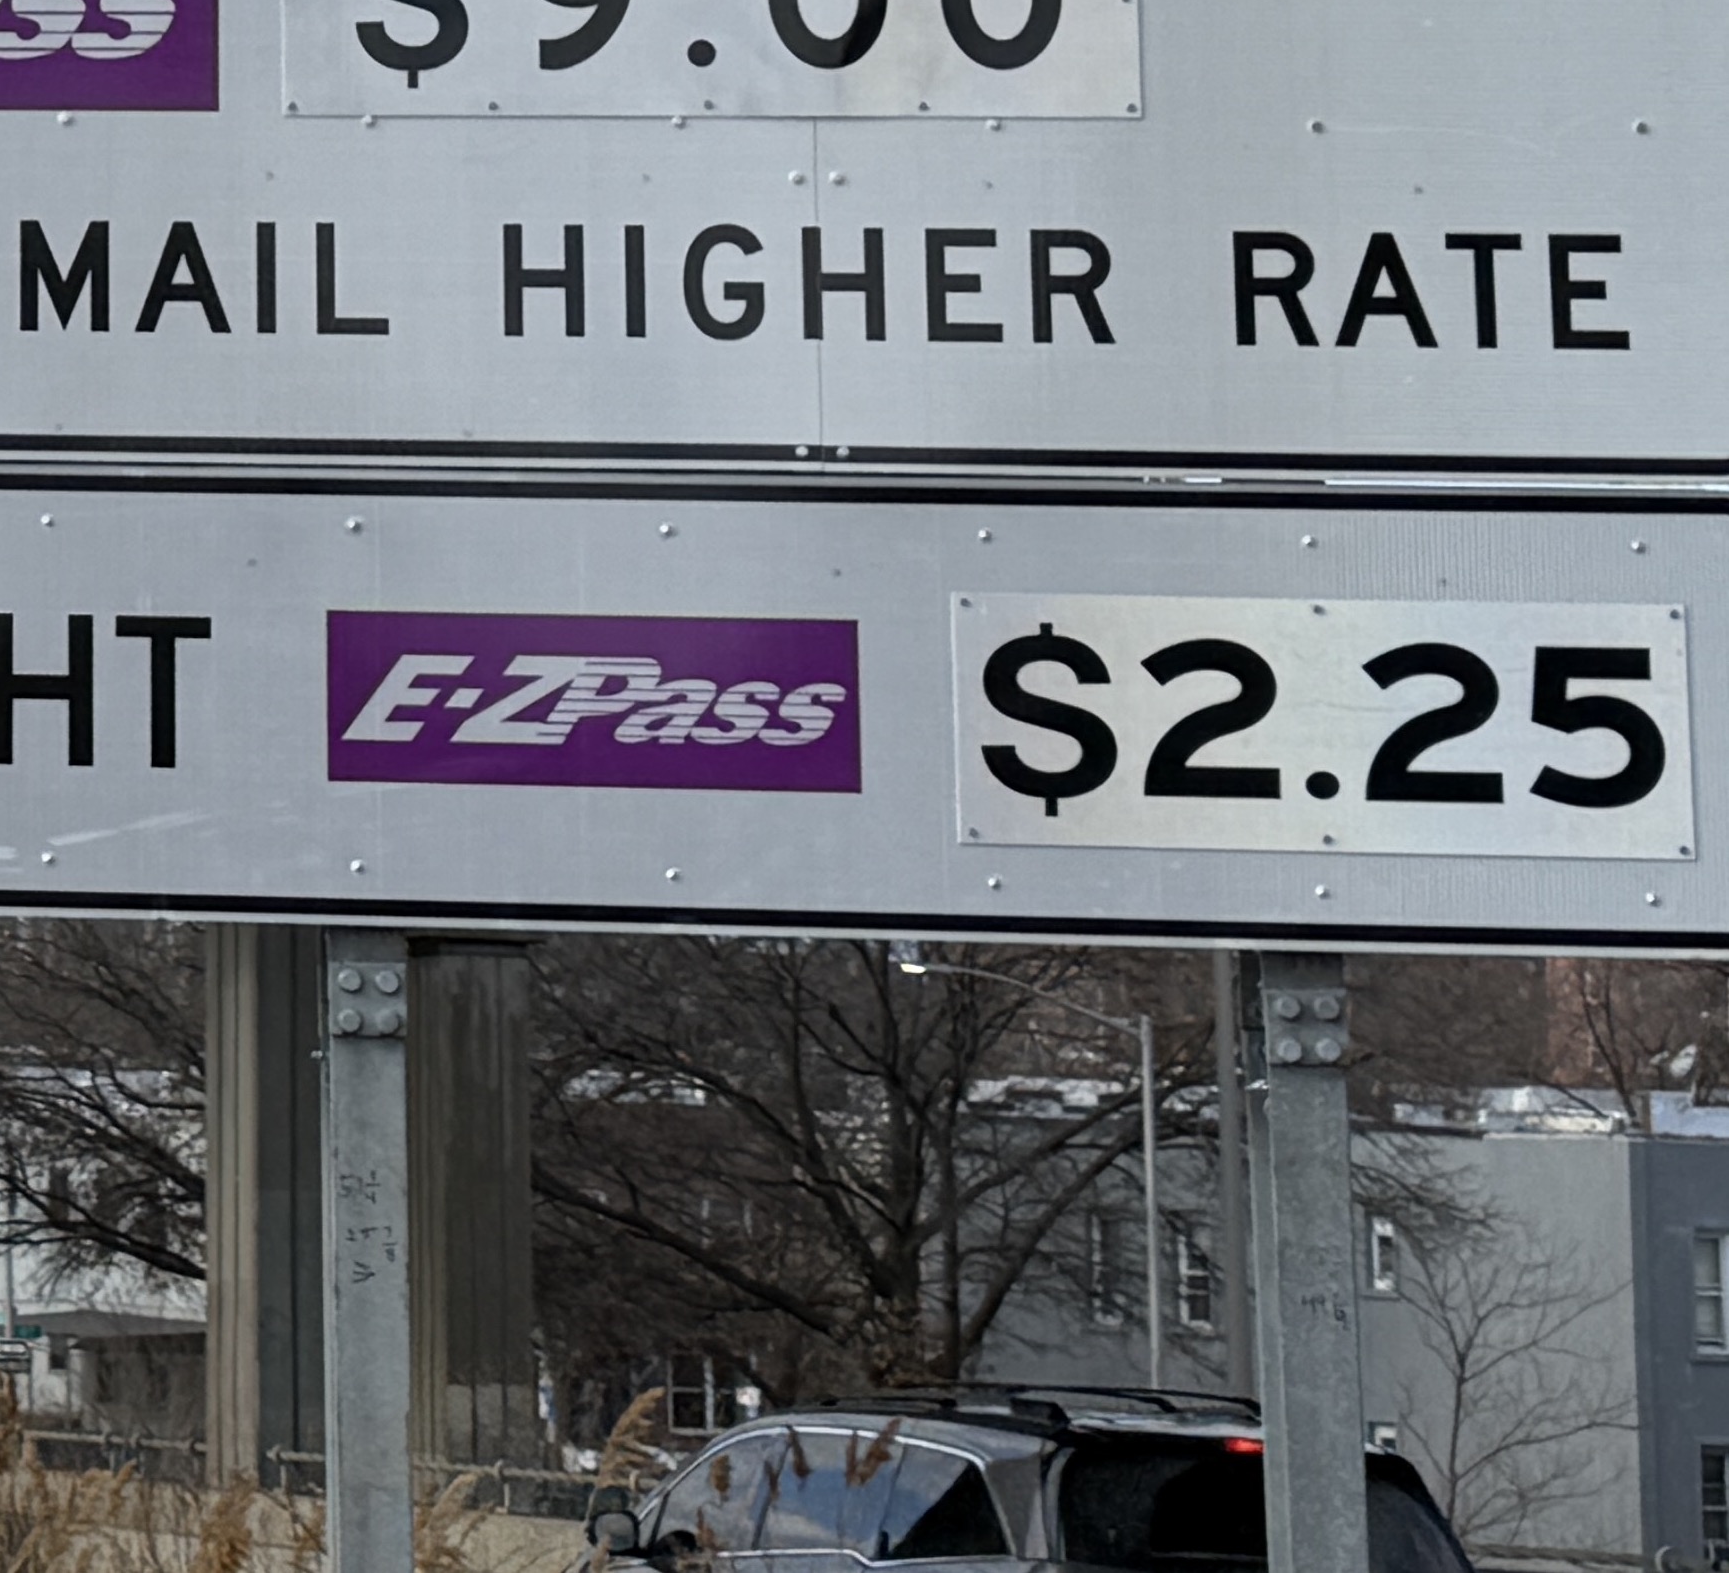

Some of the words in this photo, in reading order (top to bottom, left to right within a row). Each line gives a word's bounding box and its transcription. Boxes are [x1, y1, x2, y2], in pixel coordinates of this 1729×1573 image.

[20, 221, 389, 334] MAIL
[504, 225, 1115, 343] HIGHER
[1233, 232, 1630, 350] RATE
[982, 623, 1665, 816] $2.25
